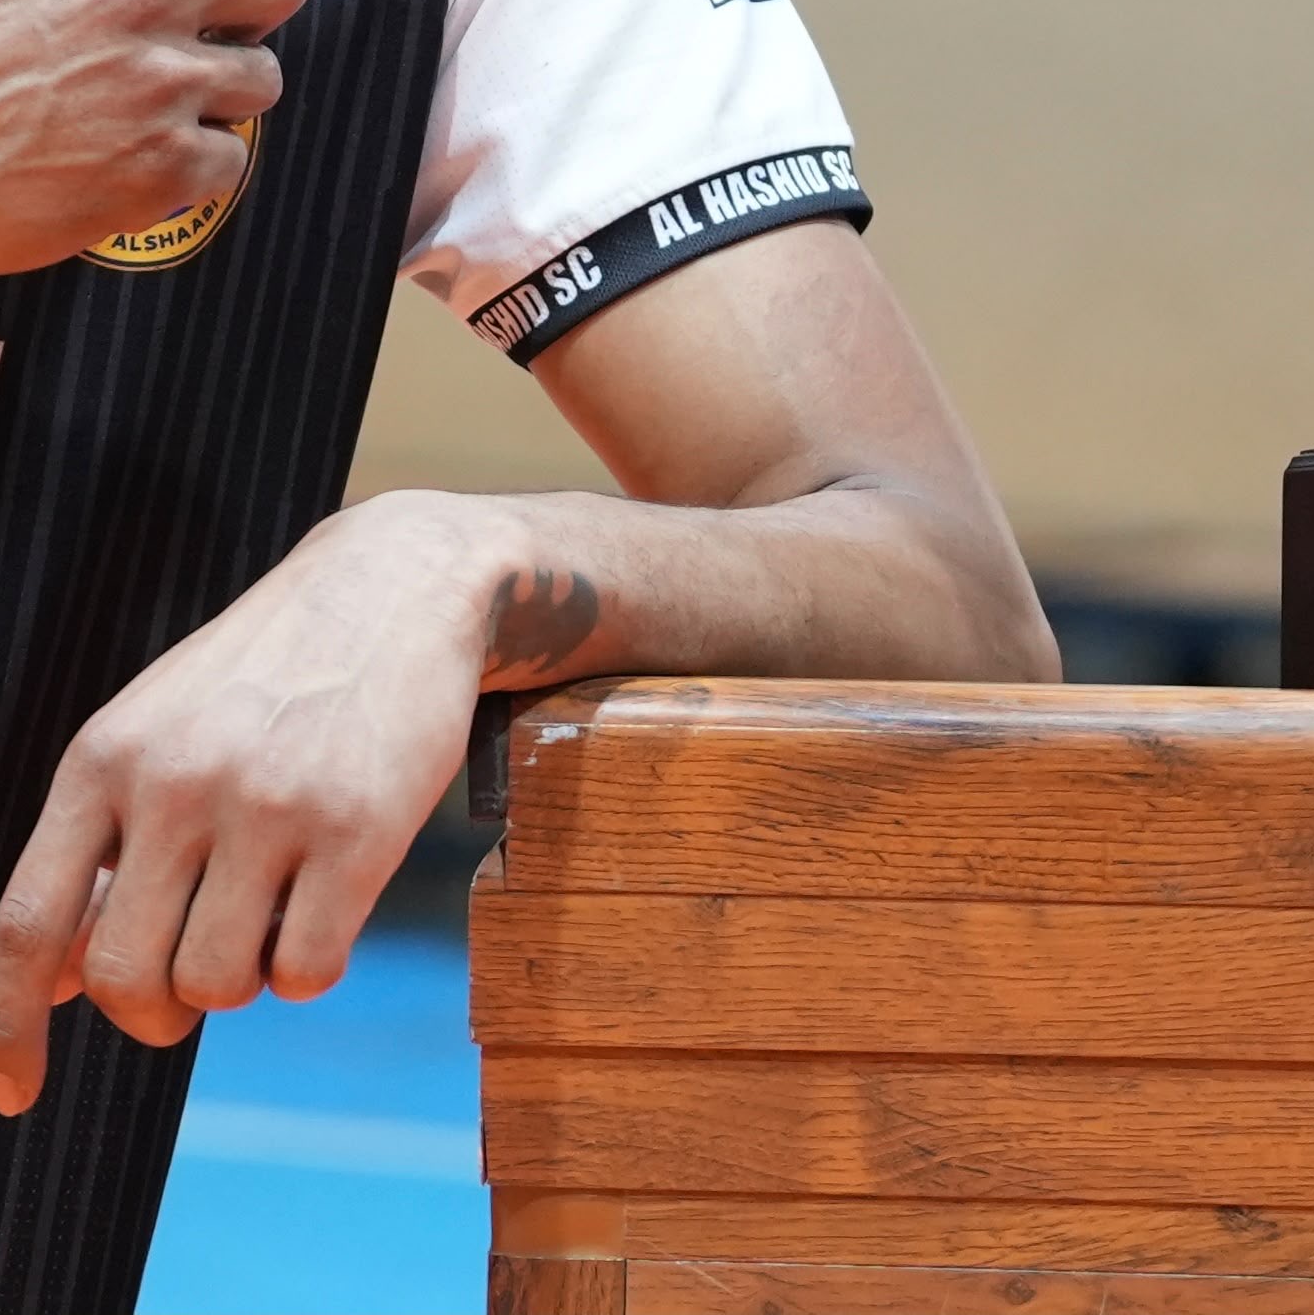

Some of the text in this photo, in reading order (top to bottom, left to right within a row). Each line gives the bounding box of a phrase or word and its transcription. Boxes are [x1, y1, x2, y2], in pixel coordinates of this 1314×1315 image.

[111, 199, 219, 252] ALSHAABI
[648, 150, 859, 249] AL HASHID SC
[543, 246, 602, 306] SC
